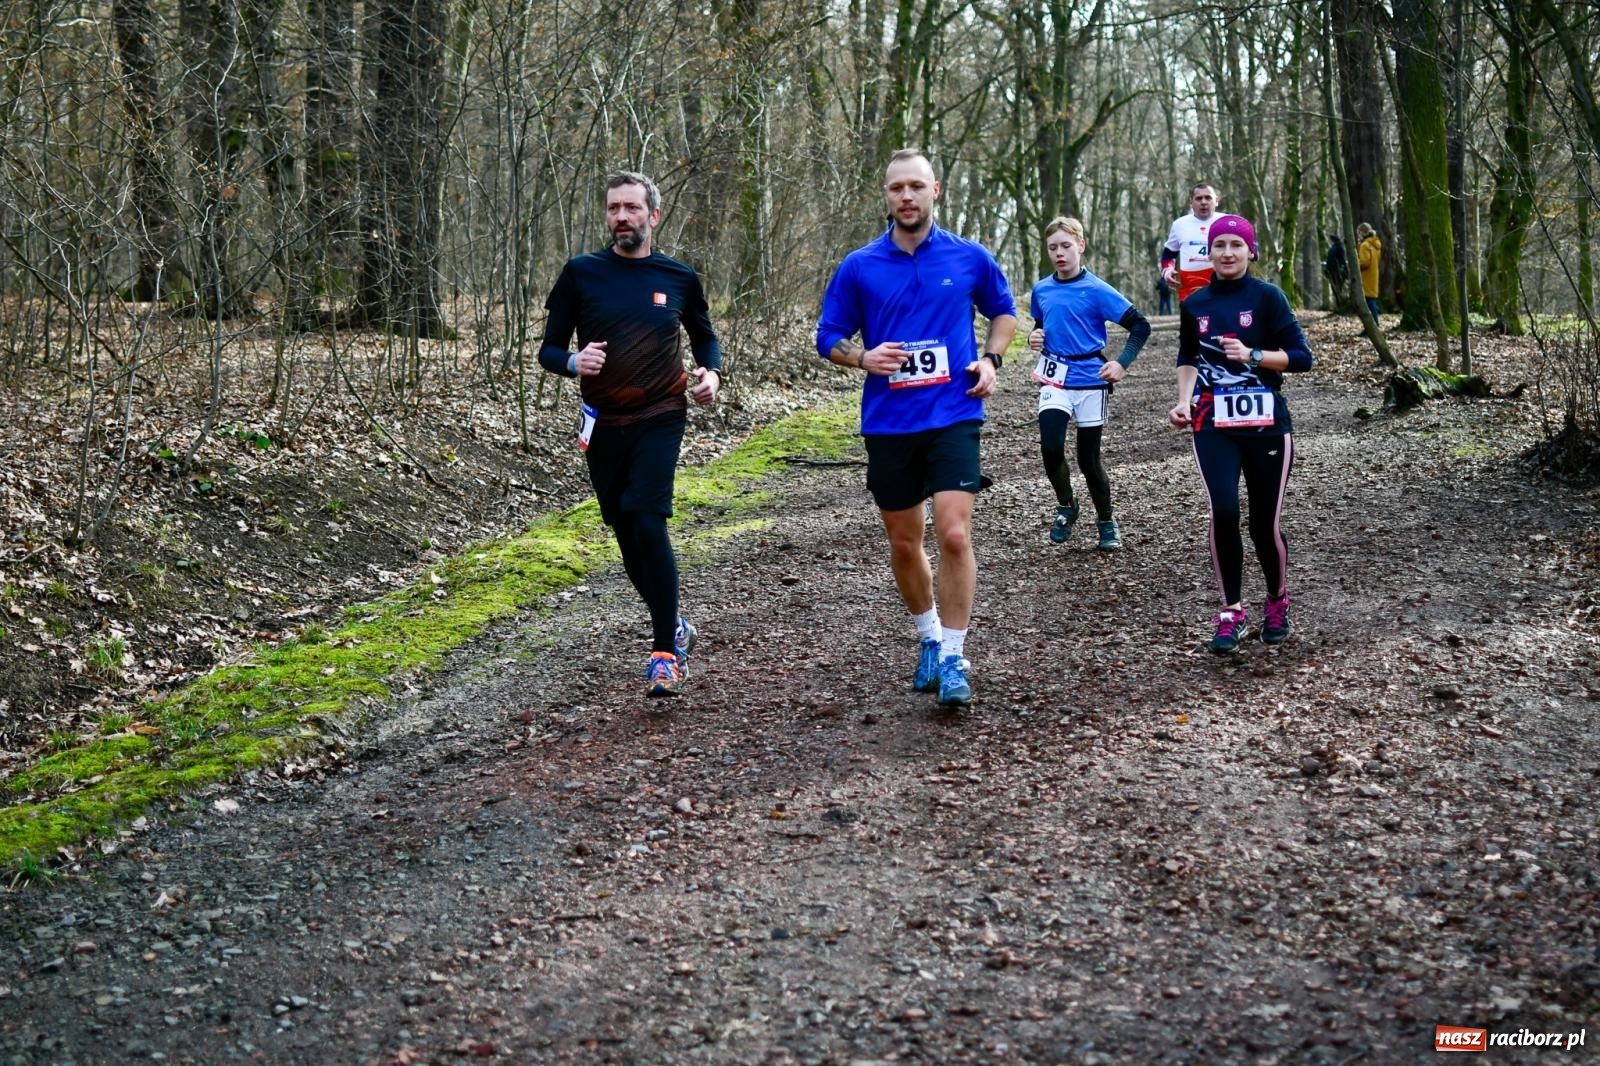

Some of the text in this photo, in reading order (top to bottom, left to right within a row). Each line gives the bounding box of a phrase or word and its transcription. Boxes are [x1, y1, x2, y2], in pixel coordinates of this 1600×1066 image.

[900, 350, 936, 376] 49
[1042, 358, 1058, 378] 18
[1224, 394, 1264, 418] 101
